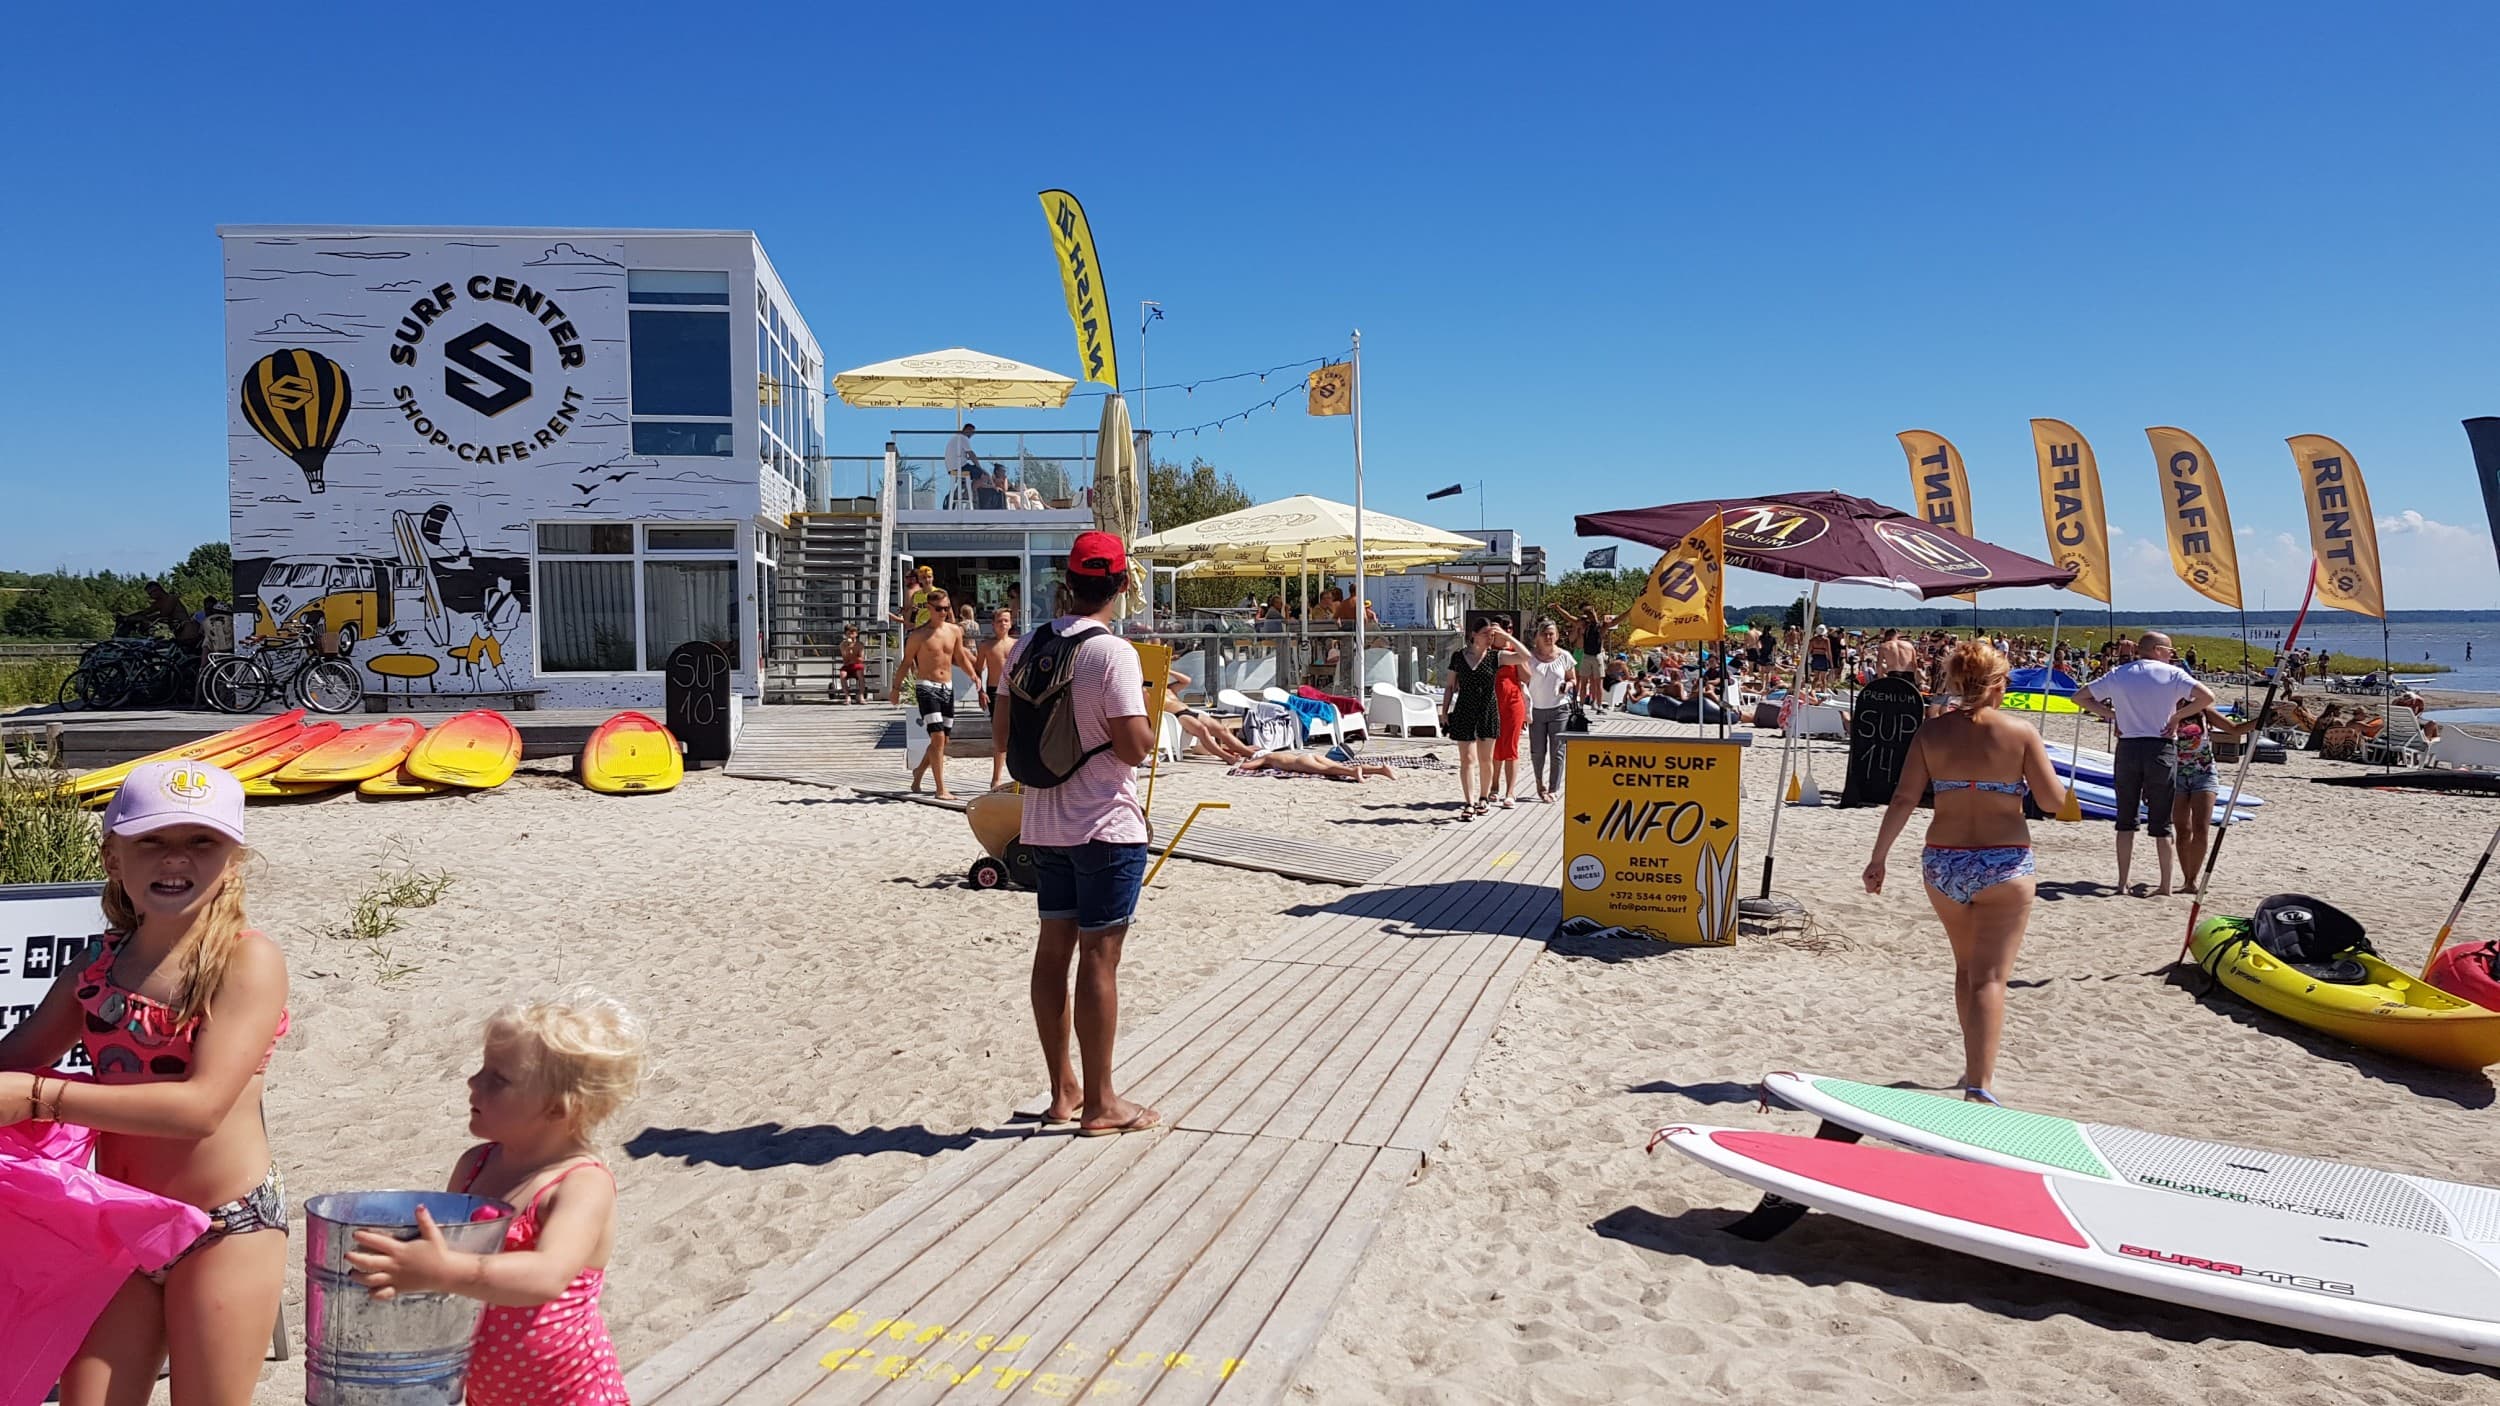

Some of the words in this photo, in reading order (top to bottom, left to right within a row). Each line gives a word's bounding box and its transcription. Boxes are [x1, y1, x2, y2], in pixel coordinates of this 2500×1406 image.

[390, 282, 456, 367] SURF
[467, 275, 586, 370] CENTER
[394, 385, 449, 446] SHOP
[457, 440, 531, 465] CAFE
[534, 386, 585, 449] RENT
[2169, 450, 2211, 556] CAFE
[2312, 456, 2356, 565] RENT
[672, 653, 728, 691] SUP
[1863, 689, 1917, 704] PREMIUM
[1858, 709, 1918, 742] SUP
[1588, 751, 1656, 769] PÄRNU
[1664, 756, 1717, 770] SURF
[1612, 772, 1689, 788] CENTER
[1597, 798, 1705, 846] INFO
[1576, 864, 1595, 872] BEST
[1615, 871, 1682, 884] COURSES
[1629, 857, 1669, 868] RENT
[1609, 891, 1632, 900] +372
[1636, 892, 1661, 901] 5344
[1665, 894, 1687, 902] 0919
[2118, 1244, 2354, 1296] DURA-TEC
